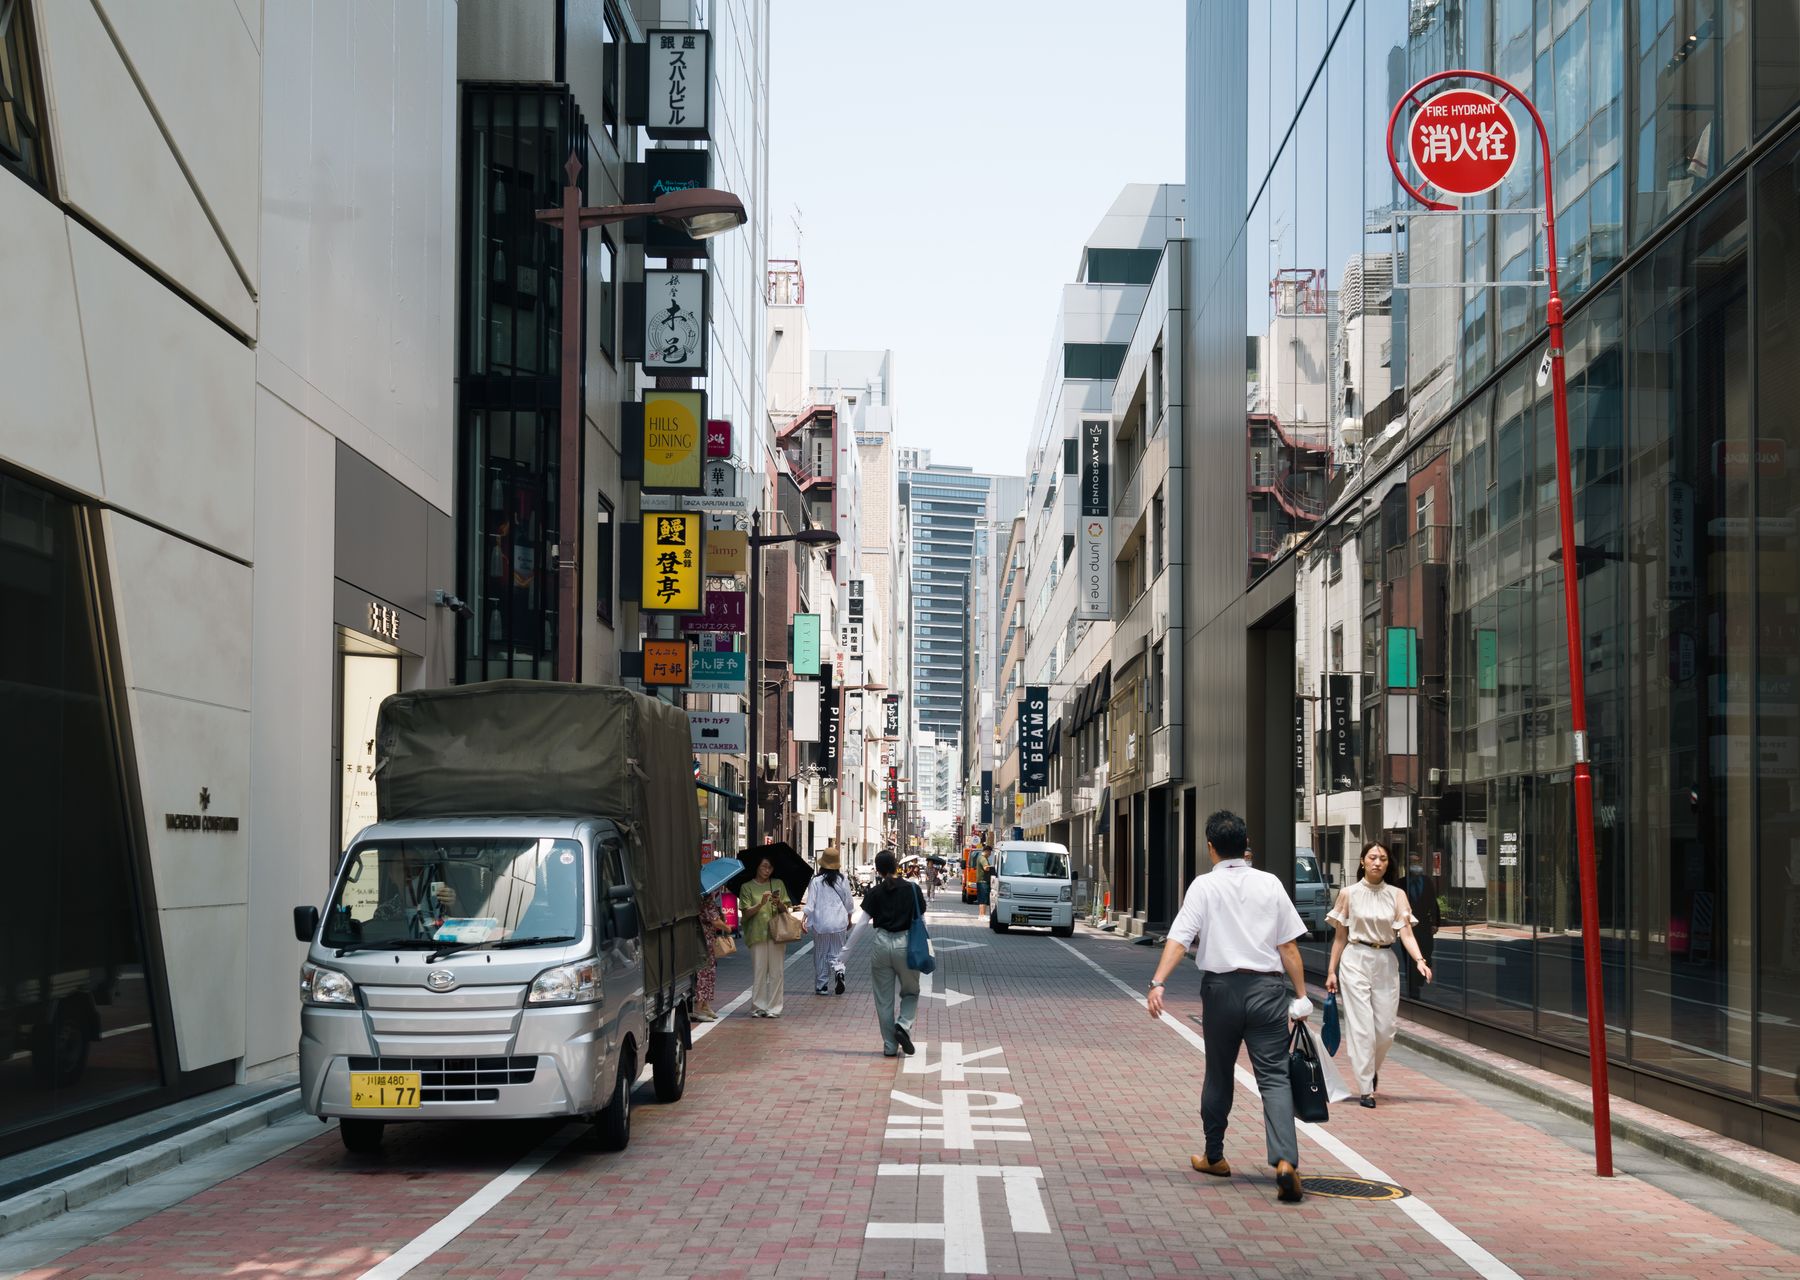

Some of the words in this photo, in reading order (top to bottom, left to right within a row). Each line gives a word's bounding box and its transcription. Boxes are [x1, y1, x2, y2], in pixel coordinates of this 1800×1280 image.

[660, 36, 696, 49] 銀座
[669, 51, 687, 125] スバルビル
[1426, 106, 1448, 117] FIRE
[1452, 104, 1496, 116] HYDRANT
[1420, 121, 1509, 163] 消火栓
[649, 417, 679, 431] HILLS
[649, 434, 692, 448] DINING
[658, 519, 685, 543] 鰻
[683, 549, 693, 568] 登録
[1088, 540, 1100, 572] jump
[656, 551, 683, 604] 登亭
[1091, 576, 1100, 599] one
[653, 663, 683, 676] 阿部
[1031, 700, 1044, 762] BEAMS
[366, 1075, 386, 1086] 川越
[387, 1075, 404, 1086] 480
